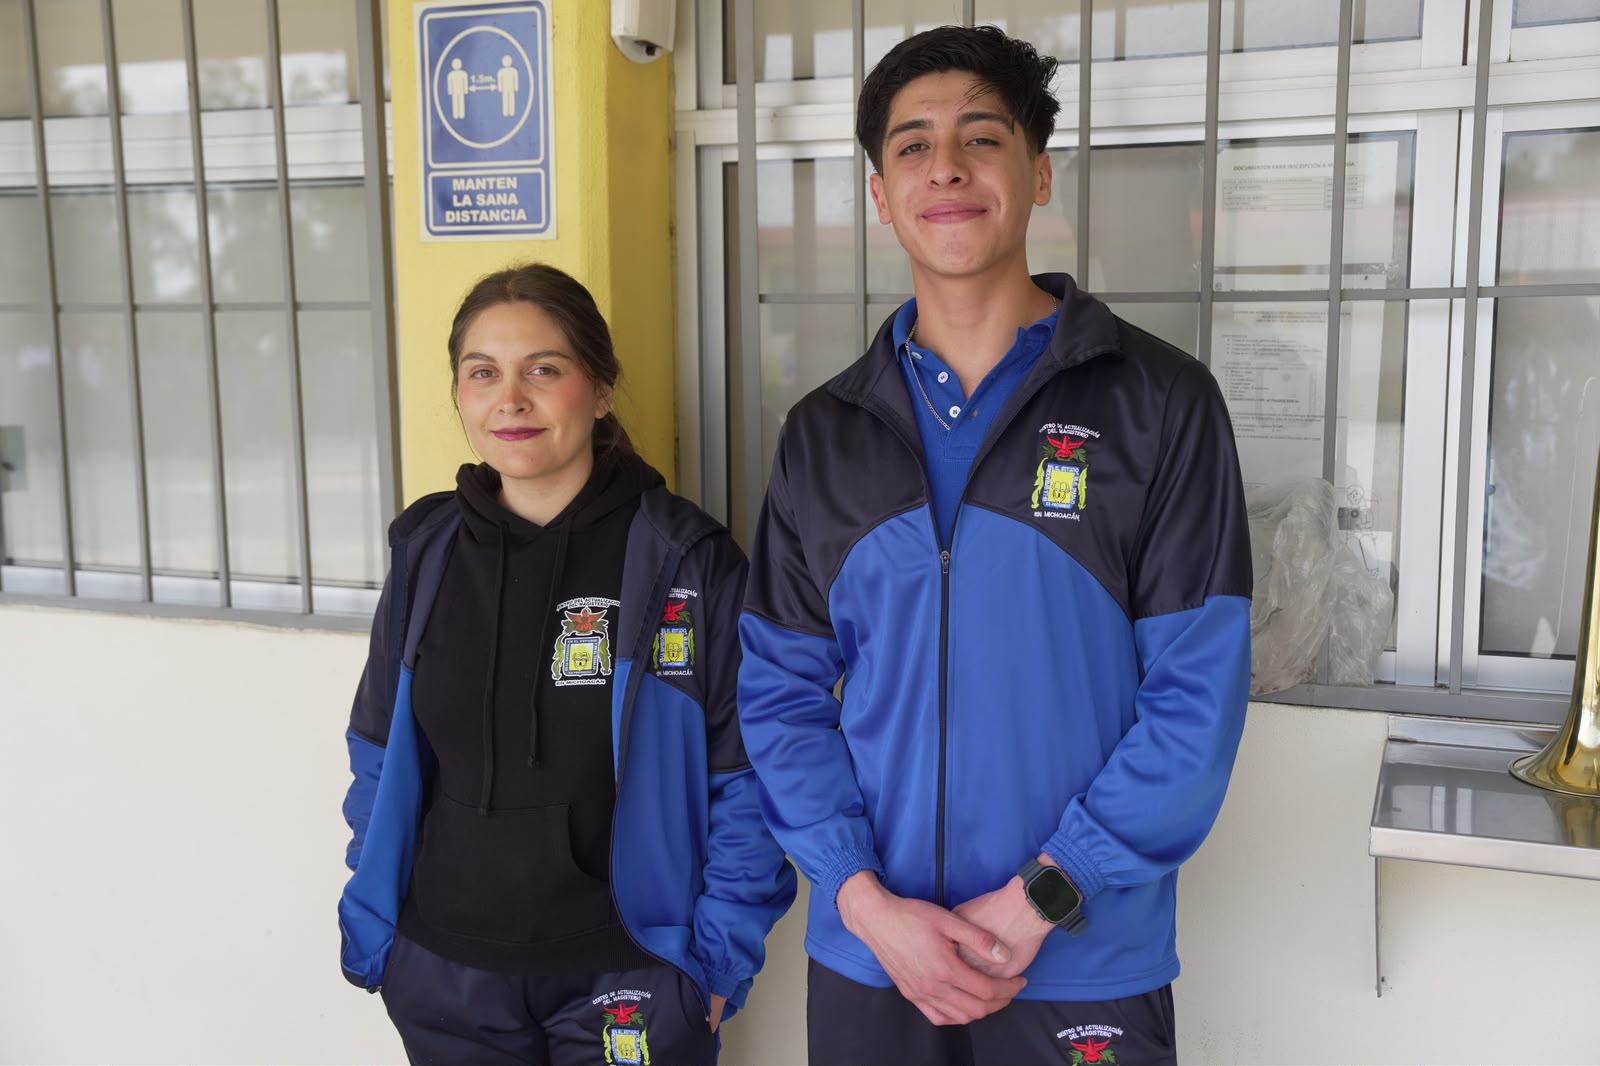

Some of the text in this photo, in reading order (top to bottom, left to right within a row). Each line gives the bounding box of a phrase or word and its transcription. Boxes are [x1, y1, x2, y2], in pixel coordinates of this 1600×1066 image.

[452, 177, 517, 191] MANTEN
[453, 193, 518, 206] LA SANA
[446, 208, 527, 223] DISTANCIA
[1044, 511, 1080, 521] MICHOACÁN
[592, 994, 608, 1005] CENTRO
[618, 990, 652, 999] ACTUALIZACIÓN
[1085, 1024, 1123, 1036] ACTUALIZACIÓN
